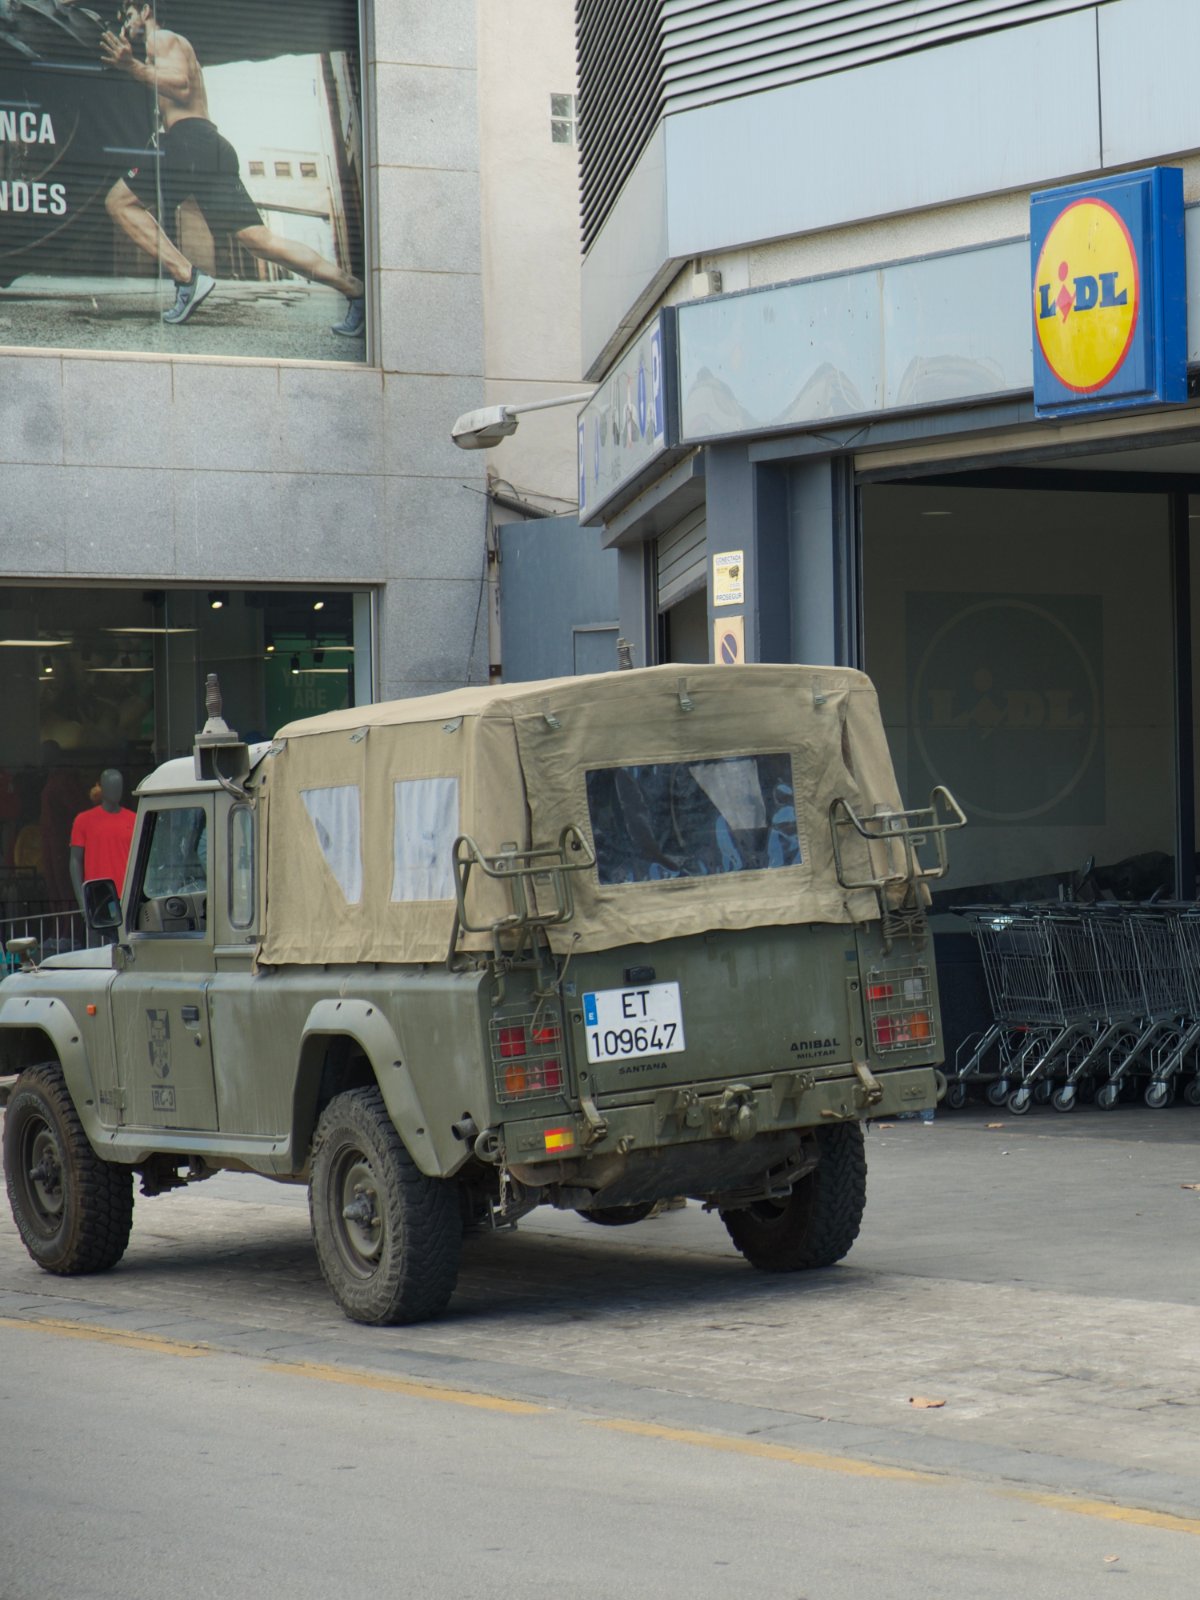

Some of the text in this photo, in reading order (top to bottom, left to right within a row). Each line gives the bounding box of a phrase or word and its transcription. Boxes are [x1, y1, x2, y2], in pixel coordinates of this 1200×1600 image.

[0, 111, 56, 144] NCA
[622, 990, 650, 1018] ET
[592, 1022, 677, 1057] 109647
[619, 1061, 668, 1075] SANTANA
